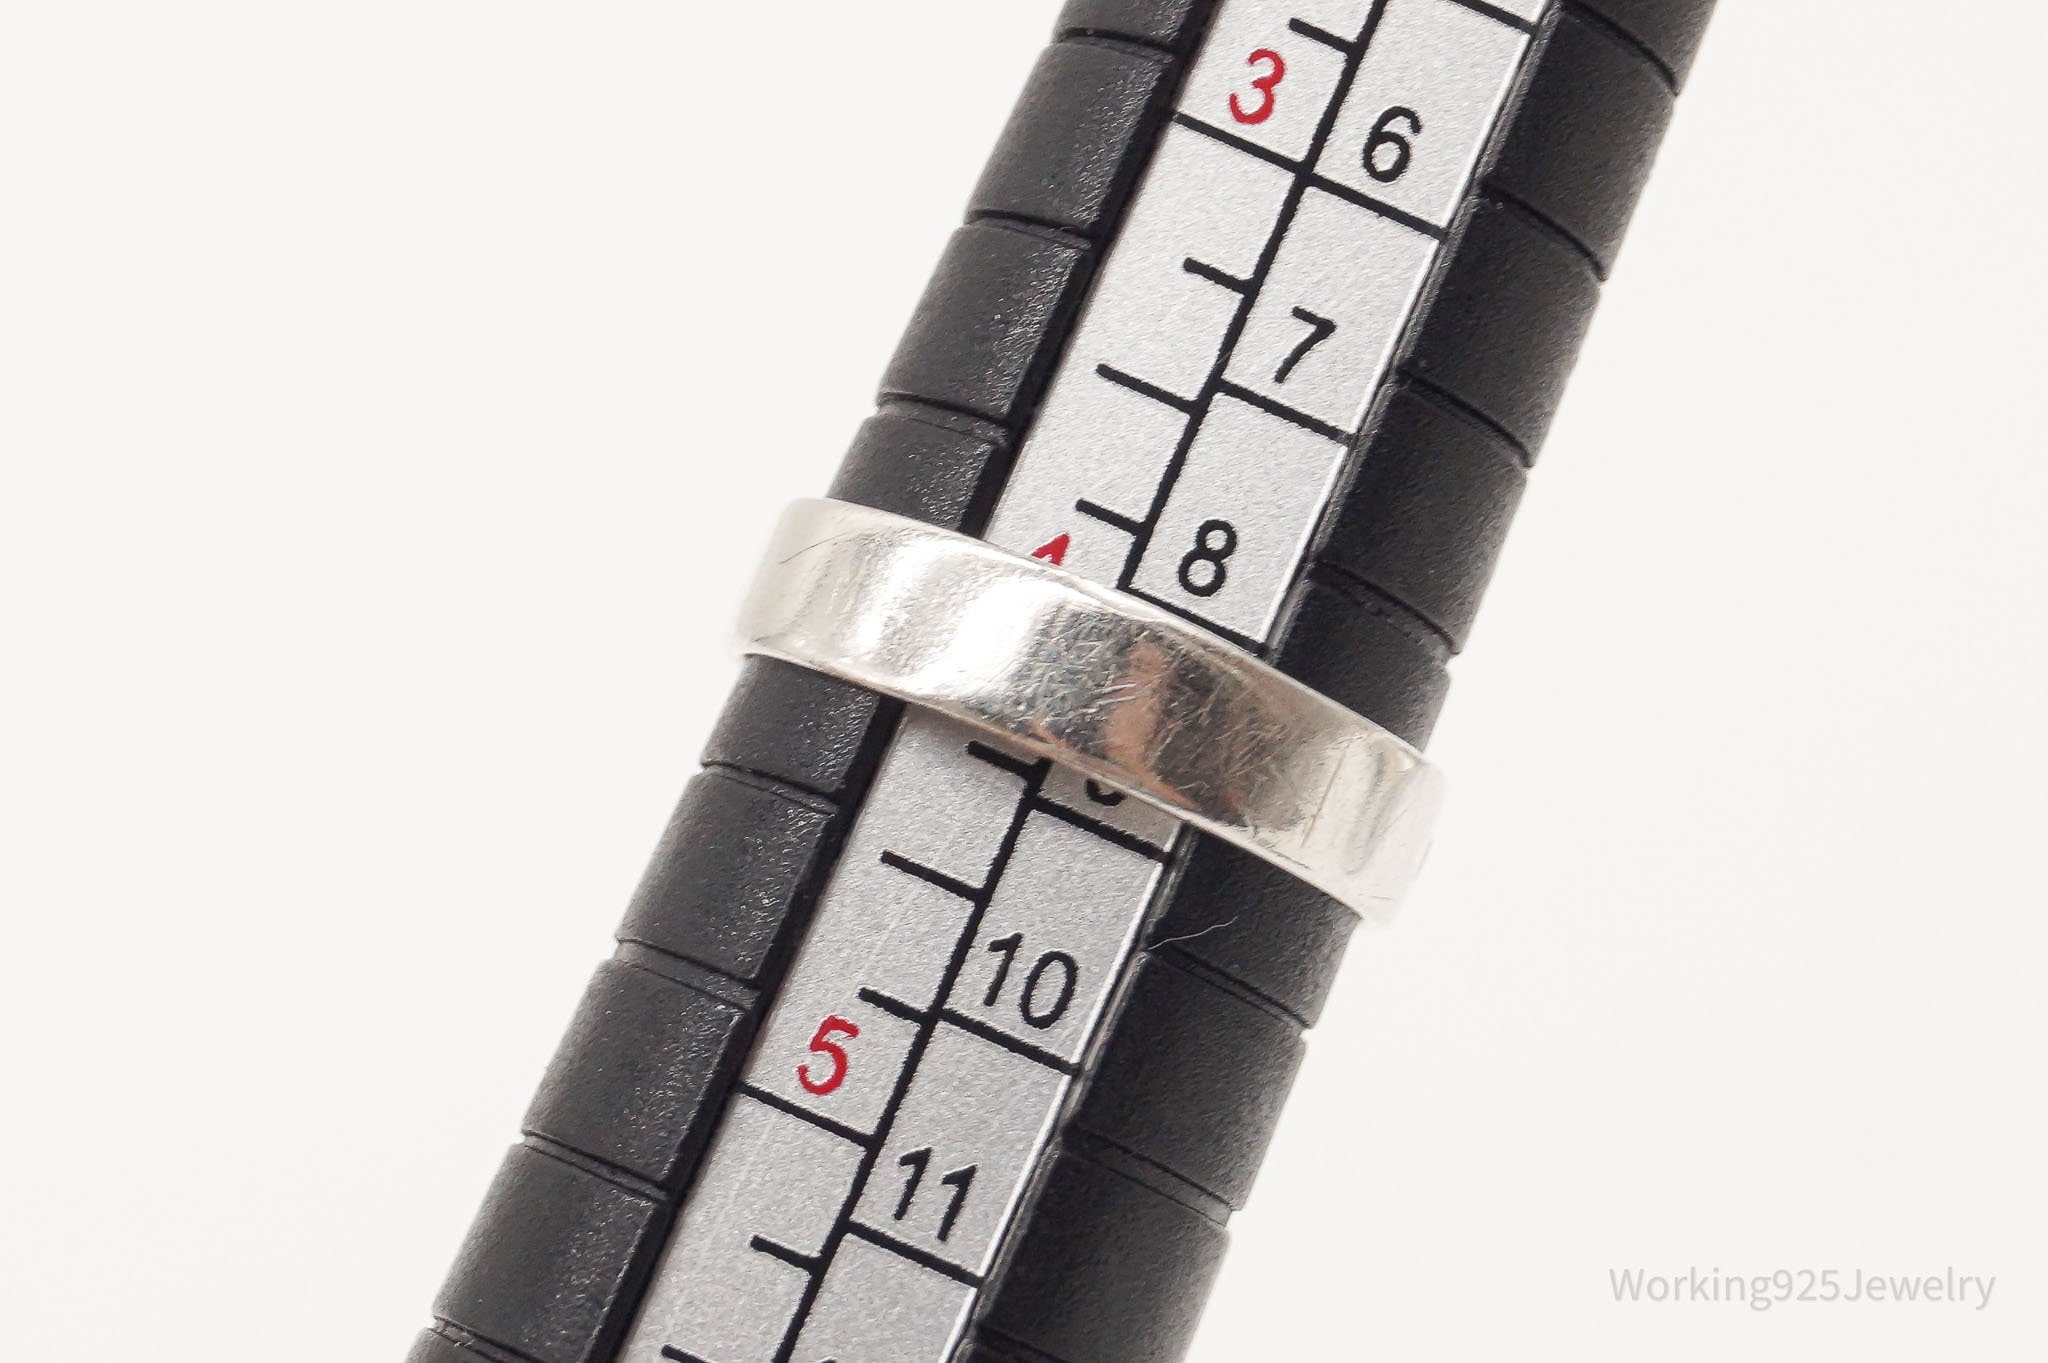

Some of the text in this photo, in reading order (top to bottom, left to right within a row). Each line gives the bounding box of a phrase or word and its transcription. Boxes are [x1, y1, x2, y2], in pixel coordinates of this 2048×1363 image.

[1228, 48, 1286, 125] 3
[1361, 106, 1422, 183] 6
[1274, 306, 1337, 384] 7
[1177, 519, 1238, 598] 8
[982, 932, 1080, 1031] 10
[797, 1015, 860, 1096] 5
[893, 1147, 978, 1243] 11
